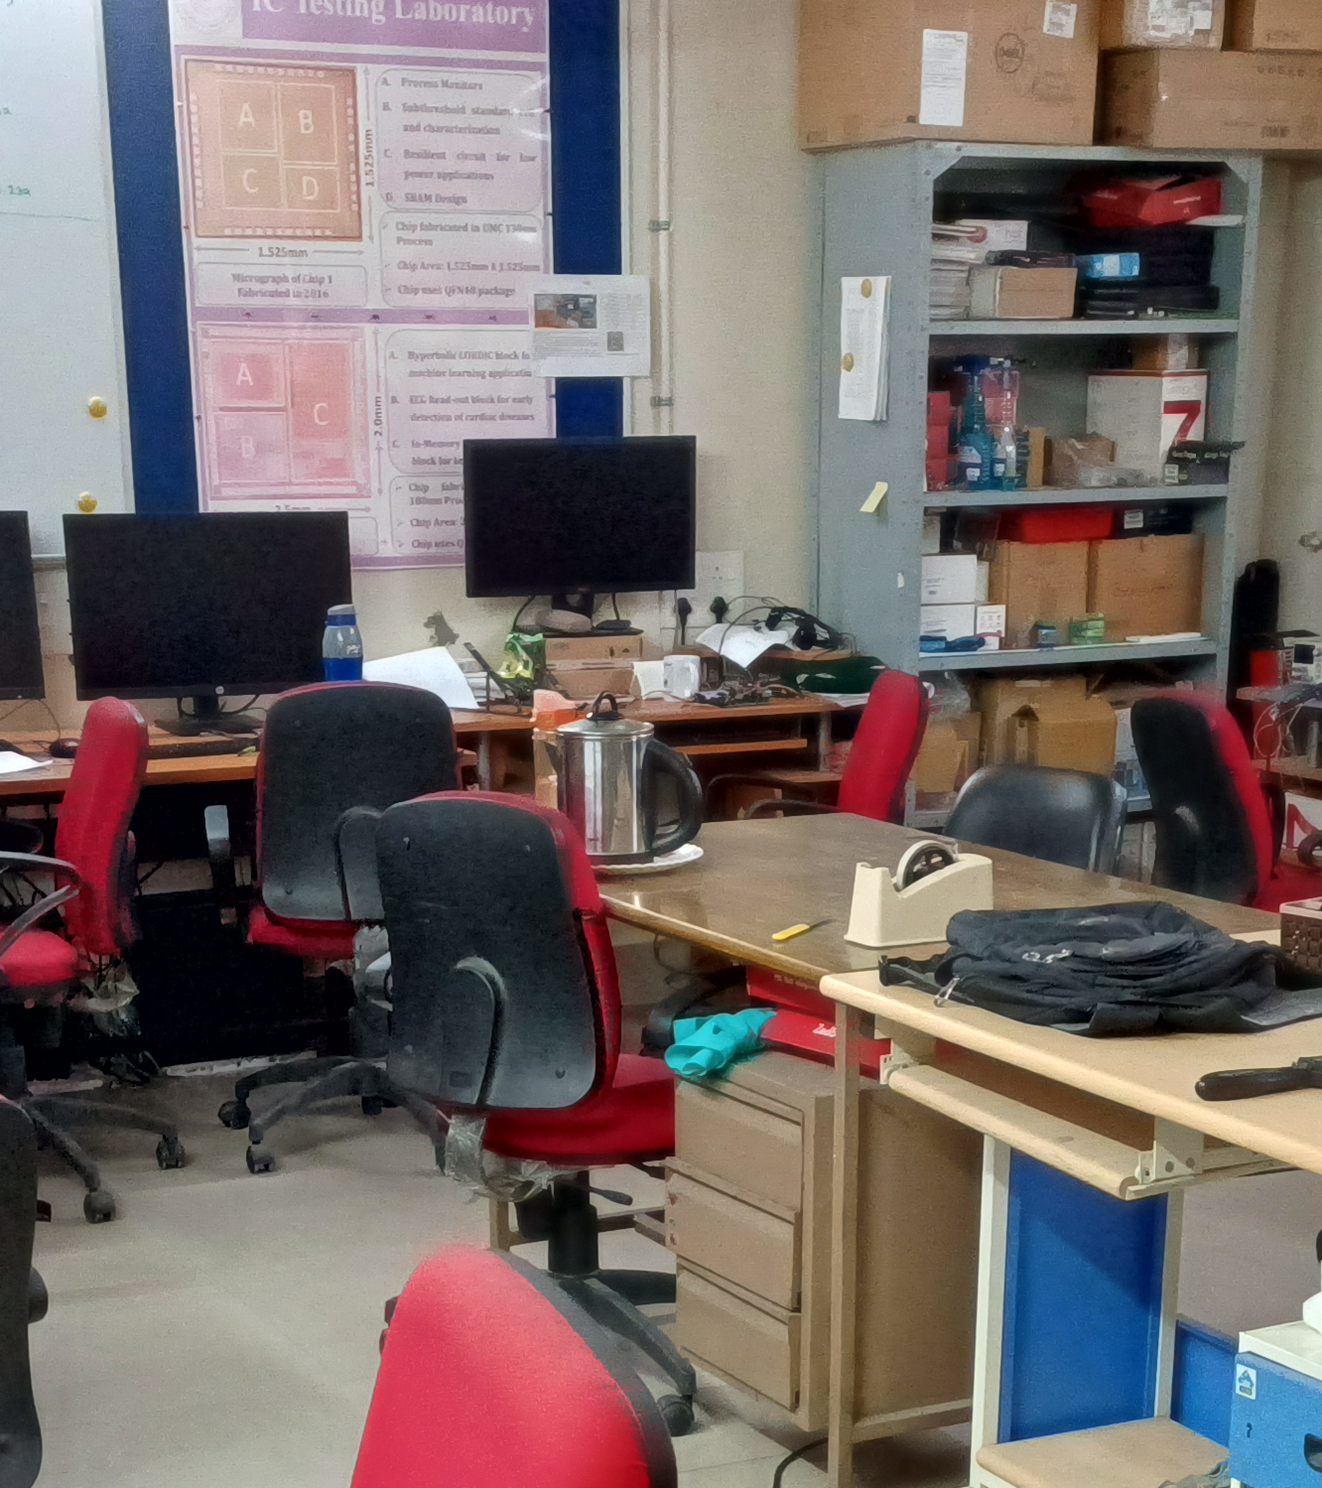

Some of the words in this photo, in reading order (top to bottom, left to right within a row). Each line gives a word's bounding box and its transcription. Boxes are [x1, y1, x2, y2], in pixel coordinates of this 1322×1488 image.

[297, 0, 386, 25] Testing
[395, 0, 535, 32] Laboratory
[401, 77, 438, 88] Process
[239, 103, 256, 129] A
[298, 110, 315, 135] B
[365, 129, 374, 187] 1.525mm
[242, 168, 259, 196] C
[302, 175, 319, 201] D
[395, 221, 418, 233] Chip
[419, 221, 468, 232] fabricated
[396, 236, 433, 246] Process
[258, 246, 308, 258] 1.525mm
[397, 260, 418, 272] Chip
[447, 261, 489, 271] 1.525mm
[231, 273, 290, 286] Micrograph
[291, 273, 301, 284] of
[237, 288, 291, 298] Fabricated
[304, 289, 330, 299] 2016
[397, 284, 419, 296] Chip
[478, 286, 516, 298] package
[236, 362, 254, 386] A
[448, 369, 487, 380] learning
[313, 402, 329, 426] C
[374, 396, 383, 437] 2.0mm
[410, 412, 452, 422] detection
[1163, 400, 1202, 447] 7
[239, 435, 256, 458] B
[409, 482, 430, 494] Chip
[410, 518, 432, 529] Chip
[412, 539, 433, 550] Chip
